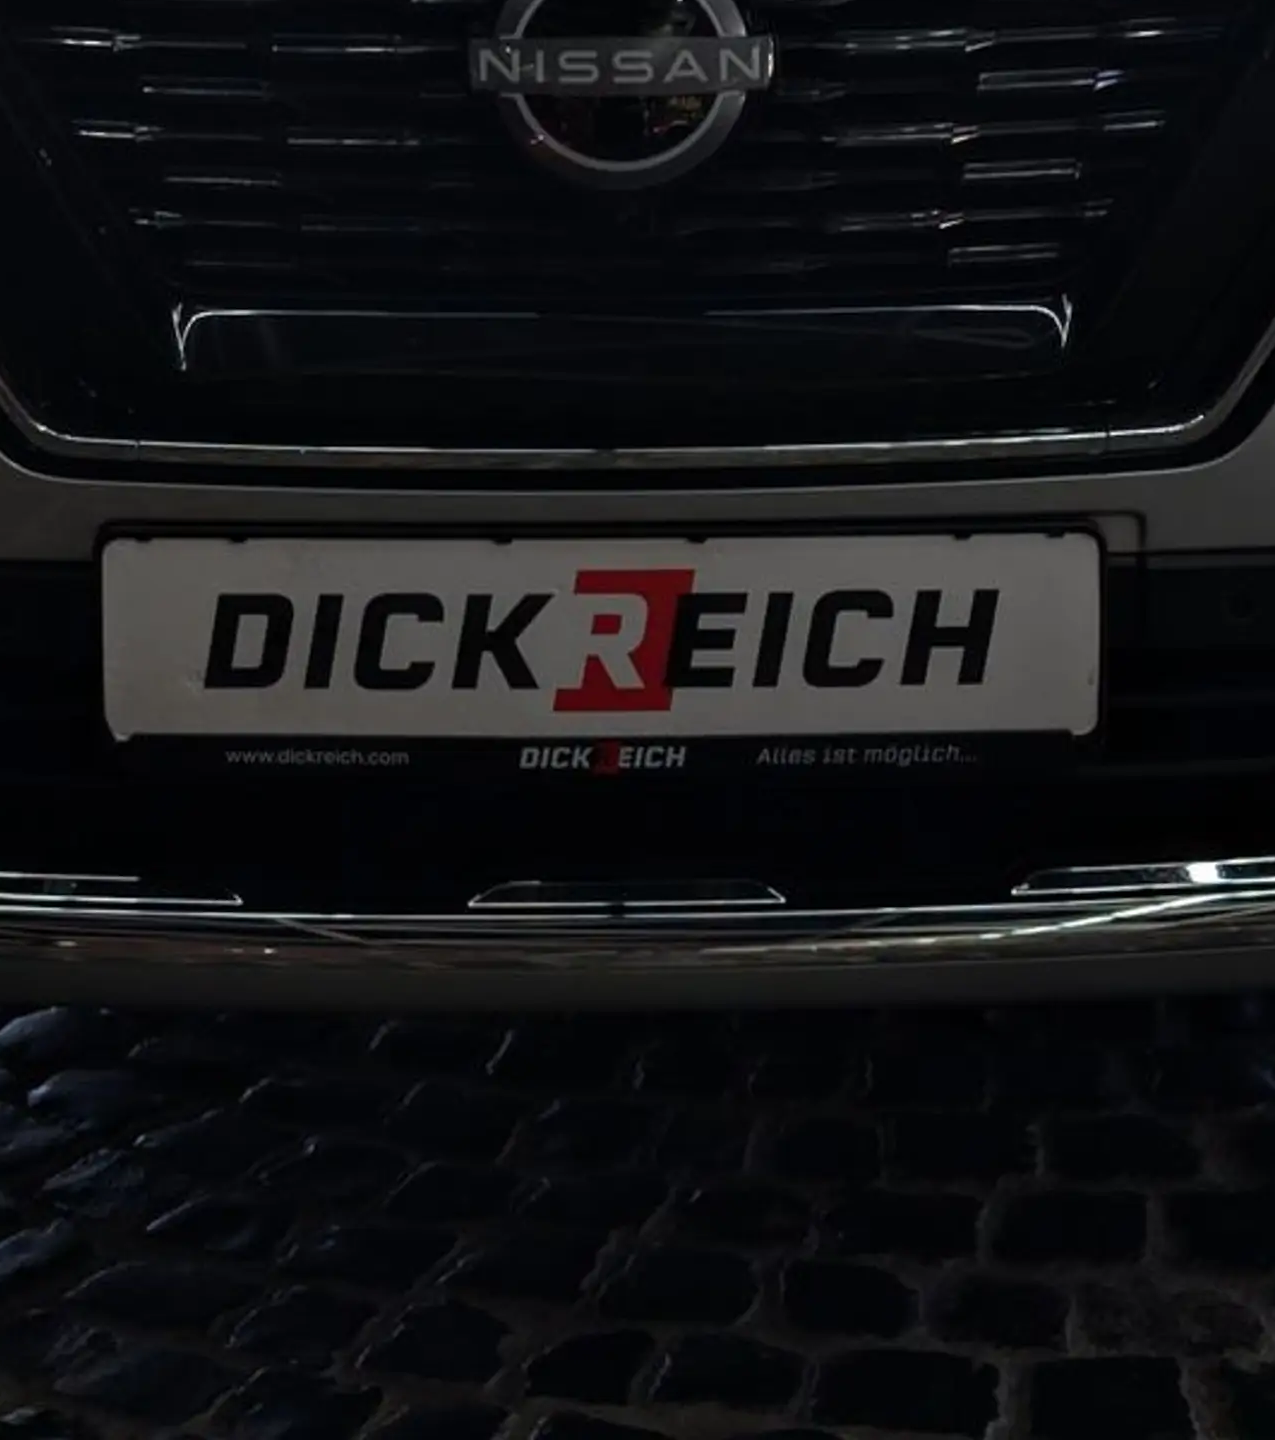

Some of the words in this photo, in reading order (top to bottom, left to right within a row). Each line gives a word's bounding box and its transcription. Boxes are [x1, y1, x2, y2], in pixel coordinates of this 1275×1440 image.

[478, 47, 763, 86] NISSAN
[203, 587, 1000, 692] DICKREICH
[224, 747, 410, 766] www.dickreich.com
[518, 744, 687, 770] DICKEICH
[755, 746, 817, 765] Alles
[822, 744, 859, 765] ist
